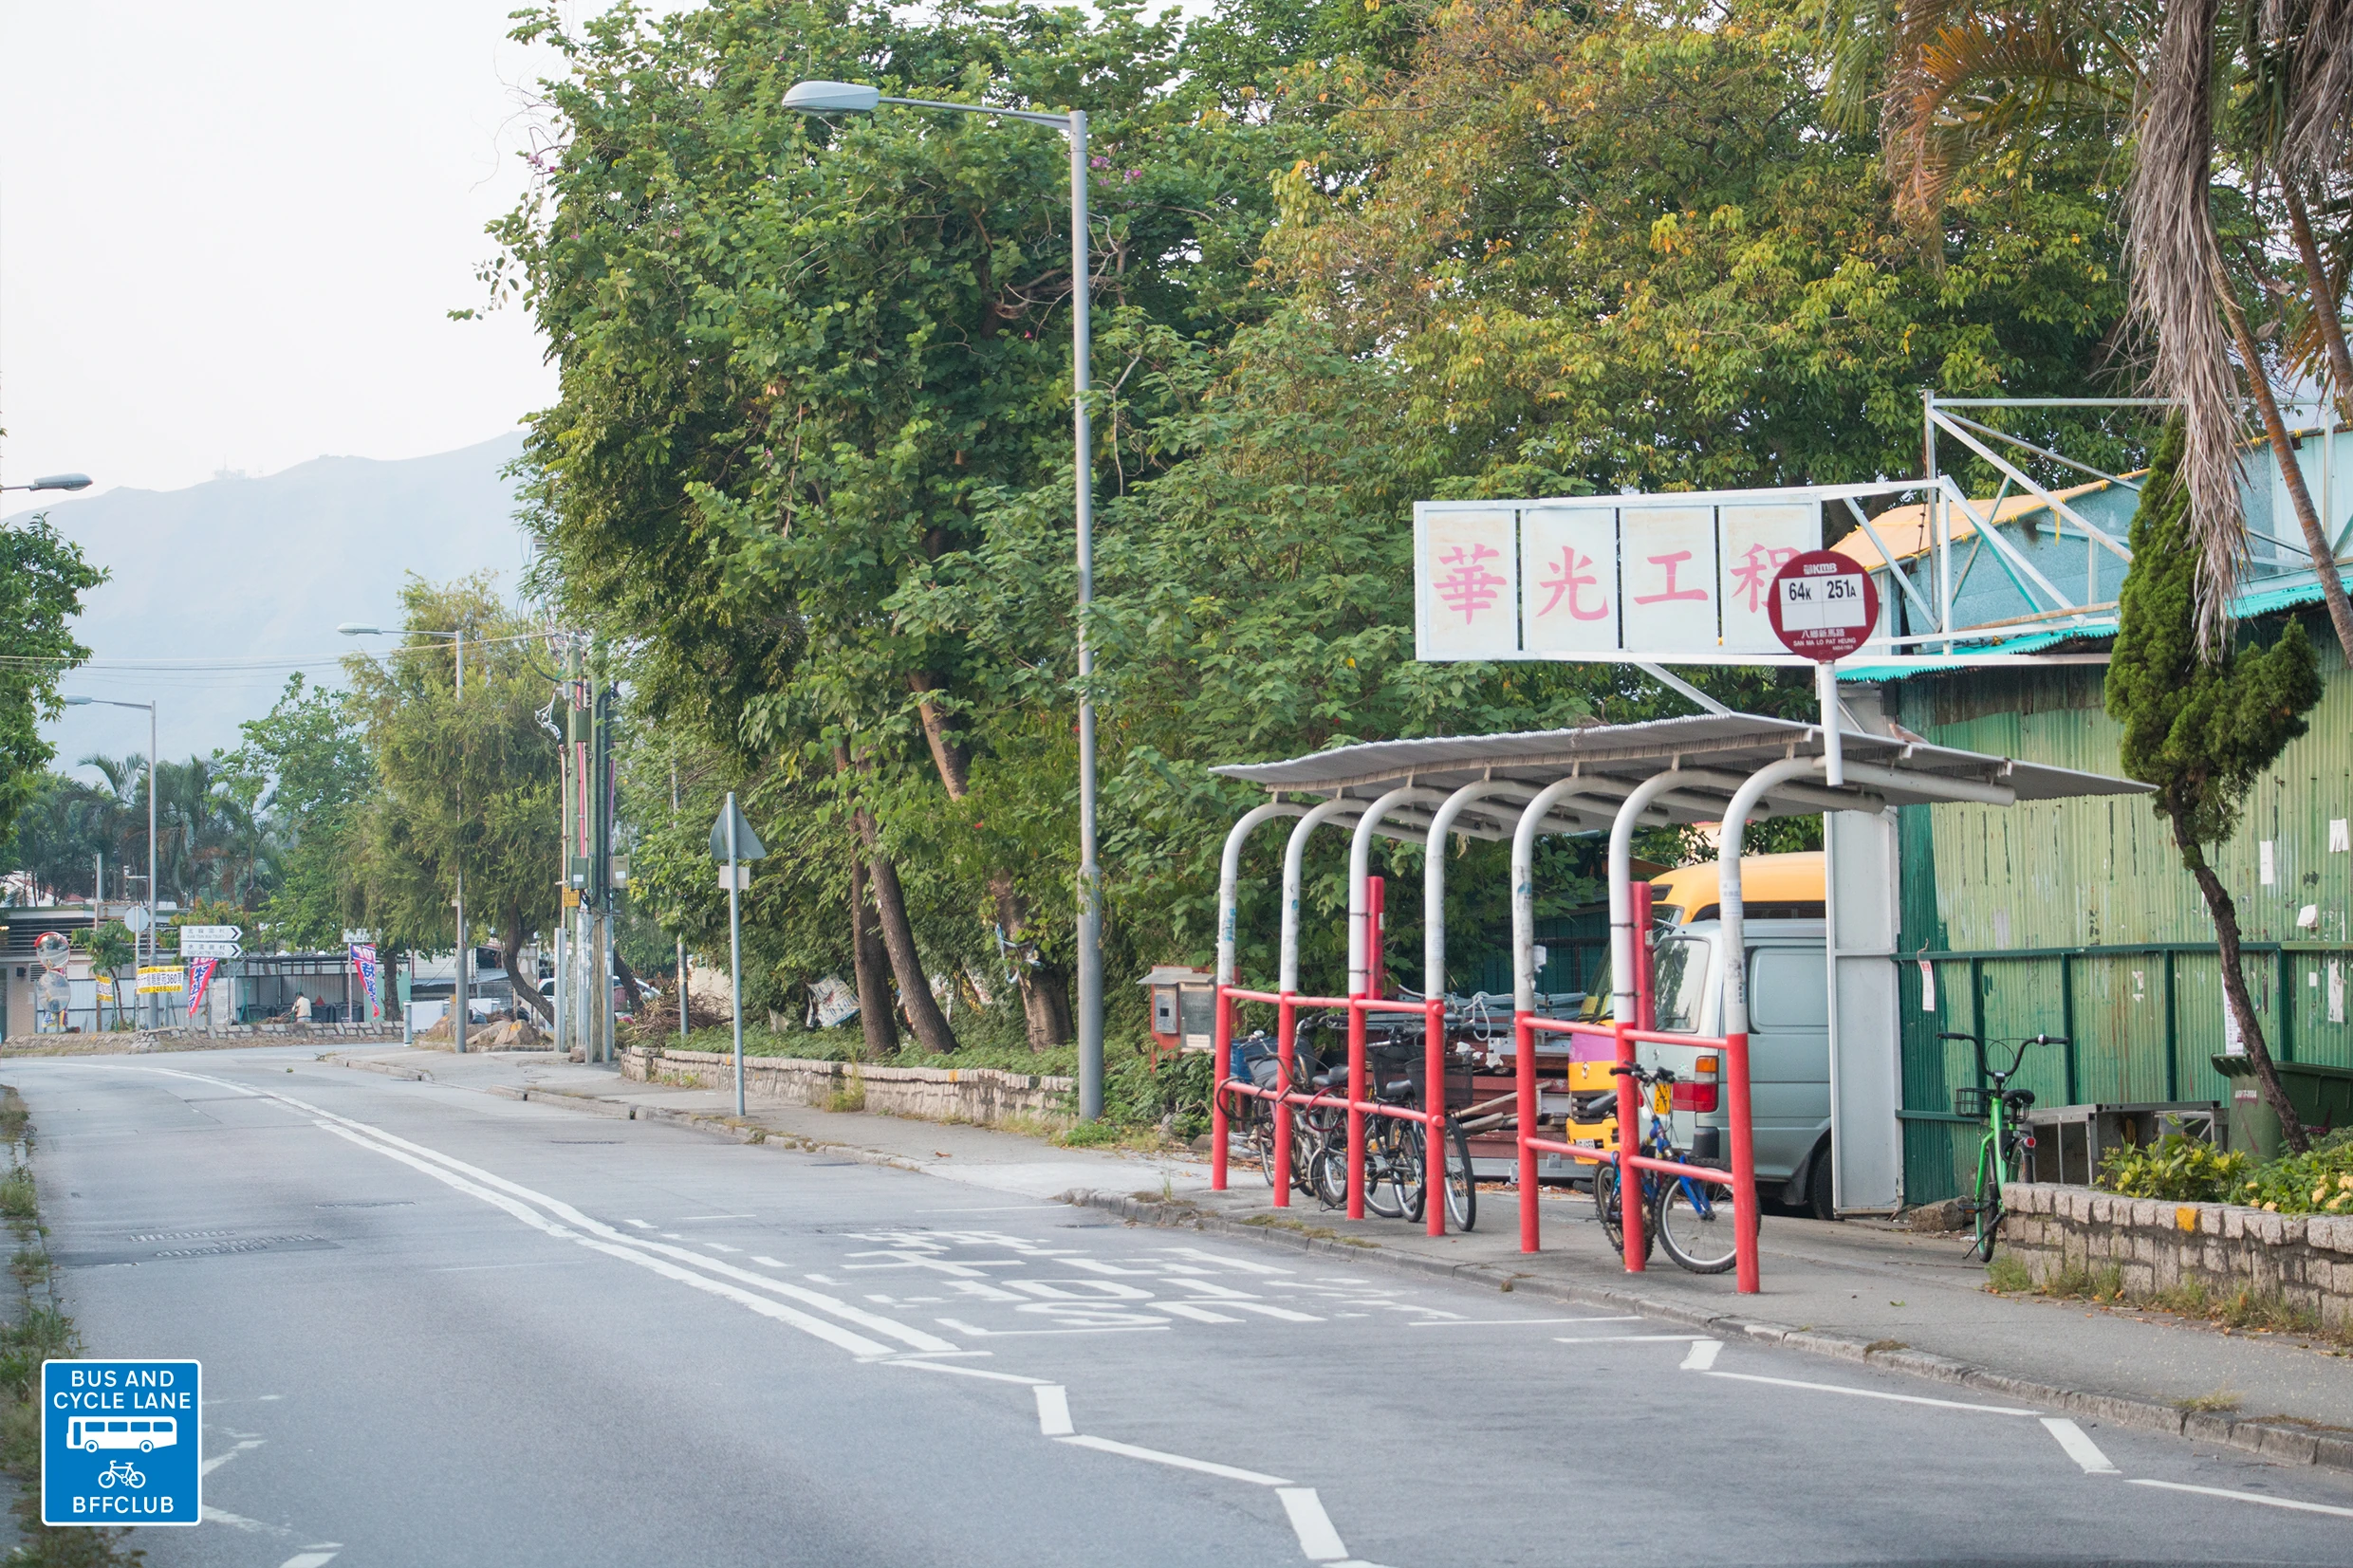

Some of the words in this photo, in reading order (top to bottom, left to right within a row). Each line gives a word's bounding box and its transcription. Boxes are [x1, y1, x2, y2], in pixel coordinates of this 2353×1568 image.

[1433, 543, 1802, 626] 華光工程
[1788, 581, 1811, 600] 64K
[1826, 580, 1856, 600] 251A
